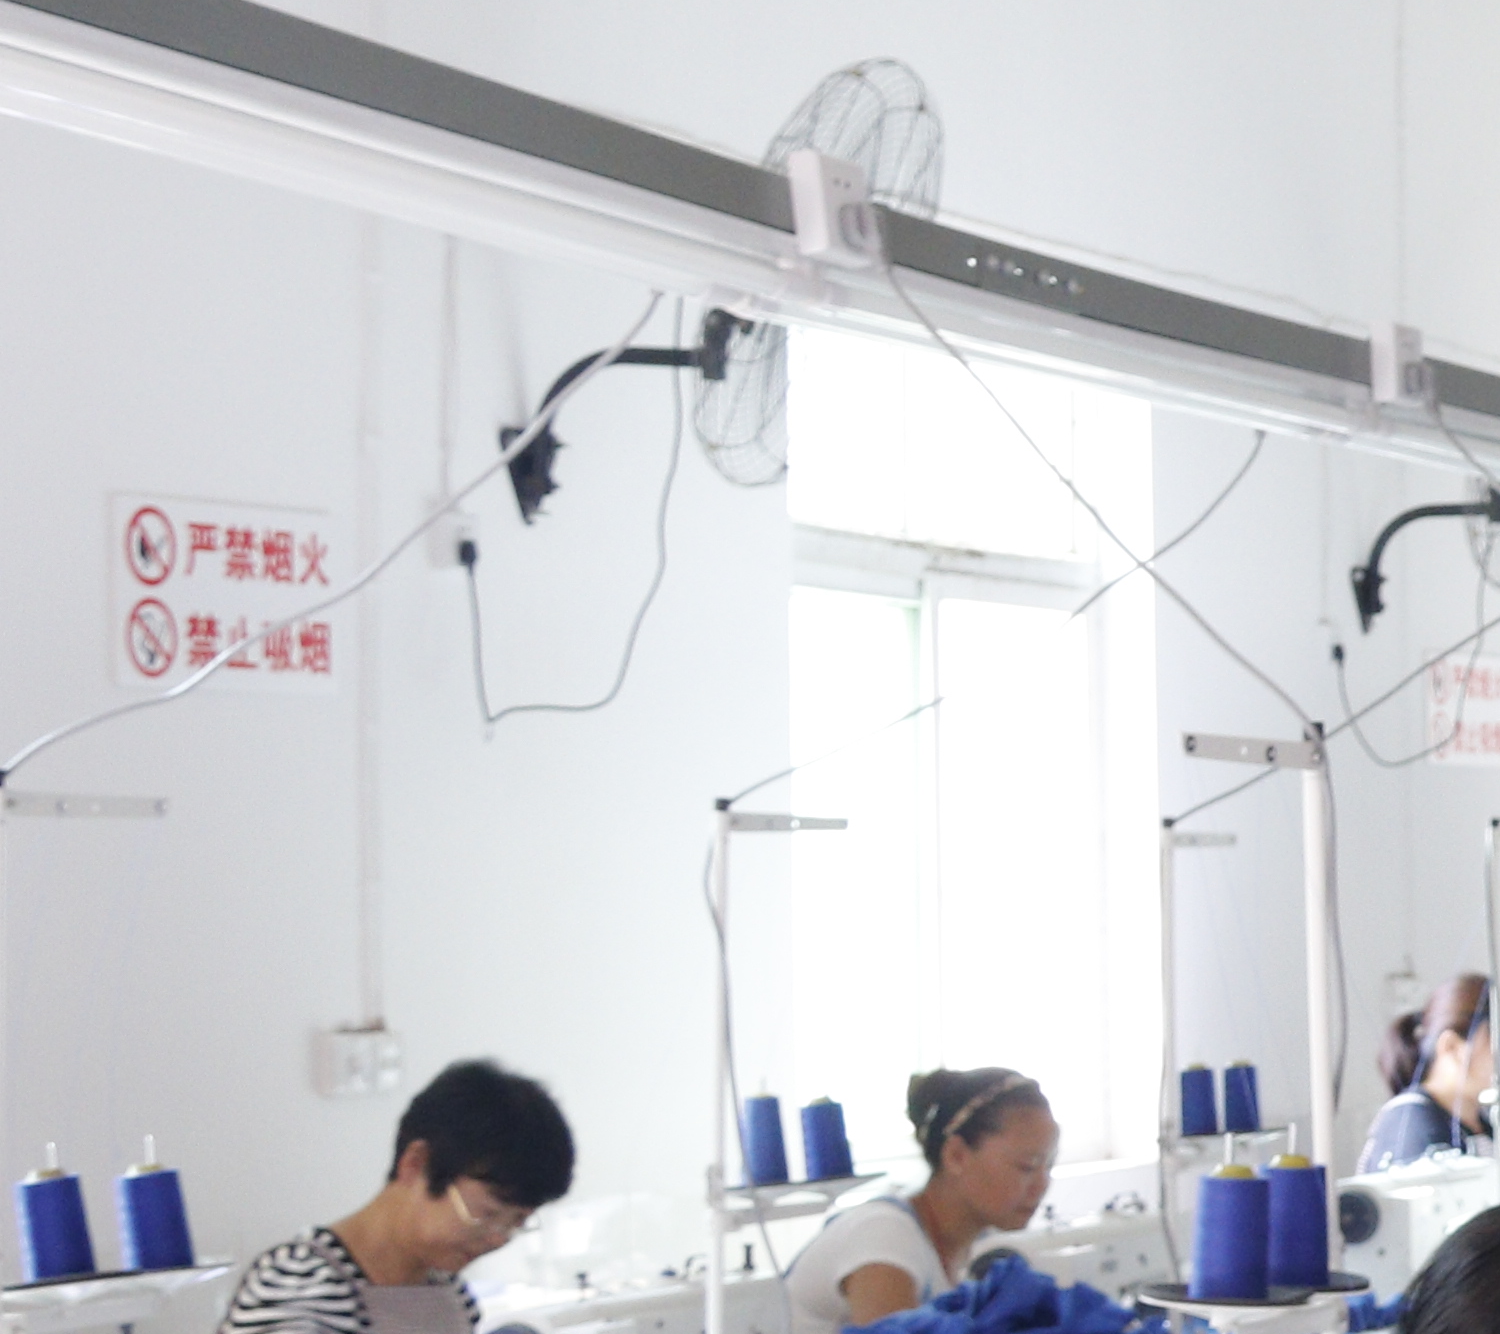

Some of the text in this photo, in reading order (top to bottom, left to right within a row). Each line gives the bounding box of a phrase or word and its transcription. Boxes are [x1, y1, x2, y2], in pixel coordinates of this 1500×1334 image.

[184, 521, 330, 586] 严禁烟火
[186, 614, 333, 675] 禁止吸烟
